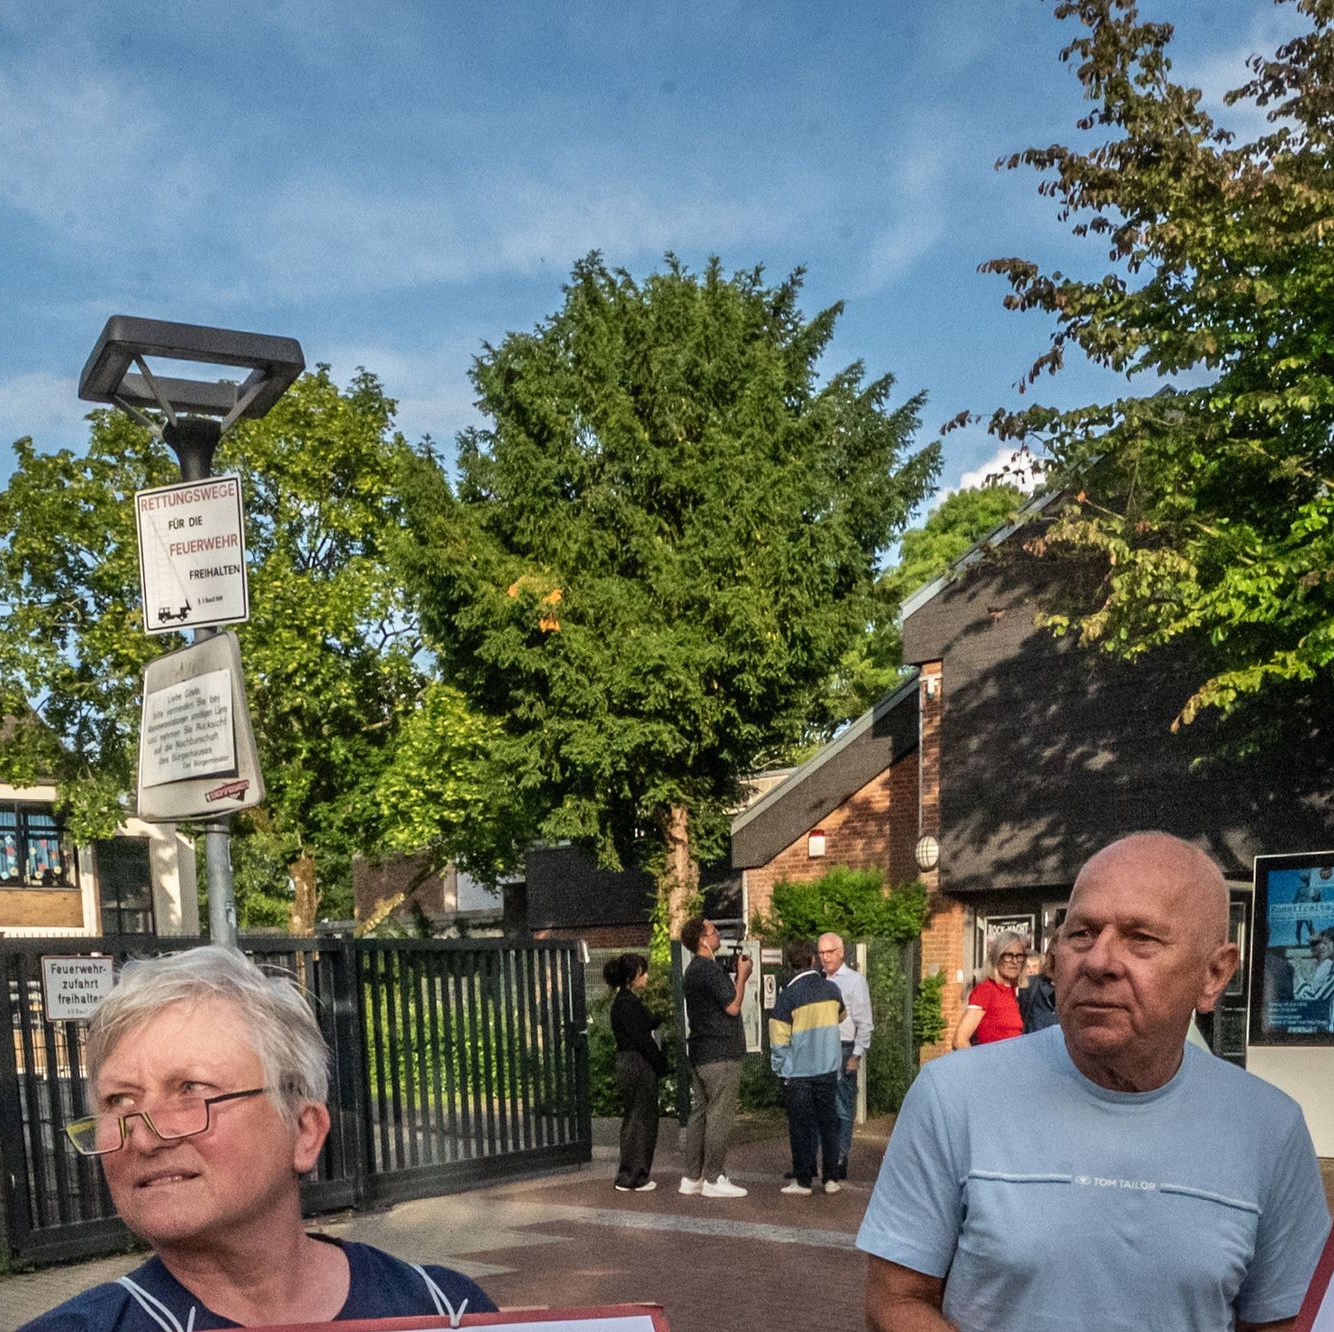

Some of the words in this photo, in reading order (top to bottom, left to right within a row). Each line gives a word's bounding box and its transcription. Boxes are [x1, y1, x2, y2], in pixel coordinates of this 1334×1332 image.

[140, 483, 235, 512] RETTUNGSWEGE
[168, 518, 185, 530] FÜR
[189, 516, 203, 527] DIE
[169, 533, 238, 557] FEUERWEHR
[189, 564, 241, 581] FREIHALTEN
[51, 963, 107, 975] Feuerwehr-
[62, 979, 99, 990] zufahrt
[1093, 1177, 1117, 1188] TOM
[1119, 1179, 1157, 1191] TAILOR
